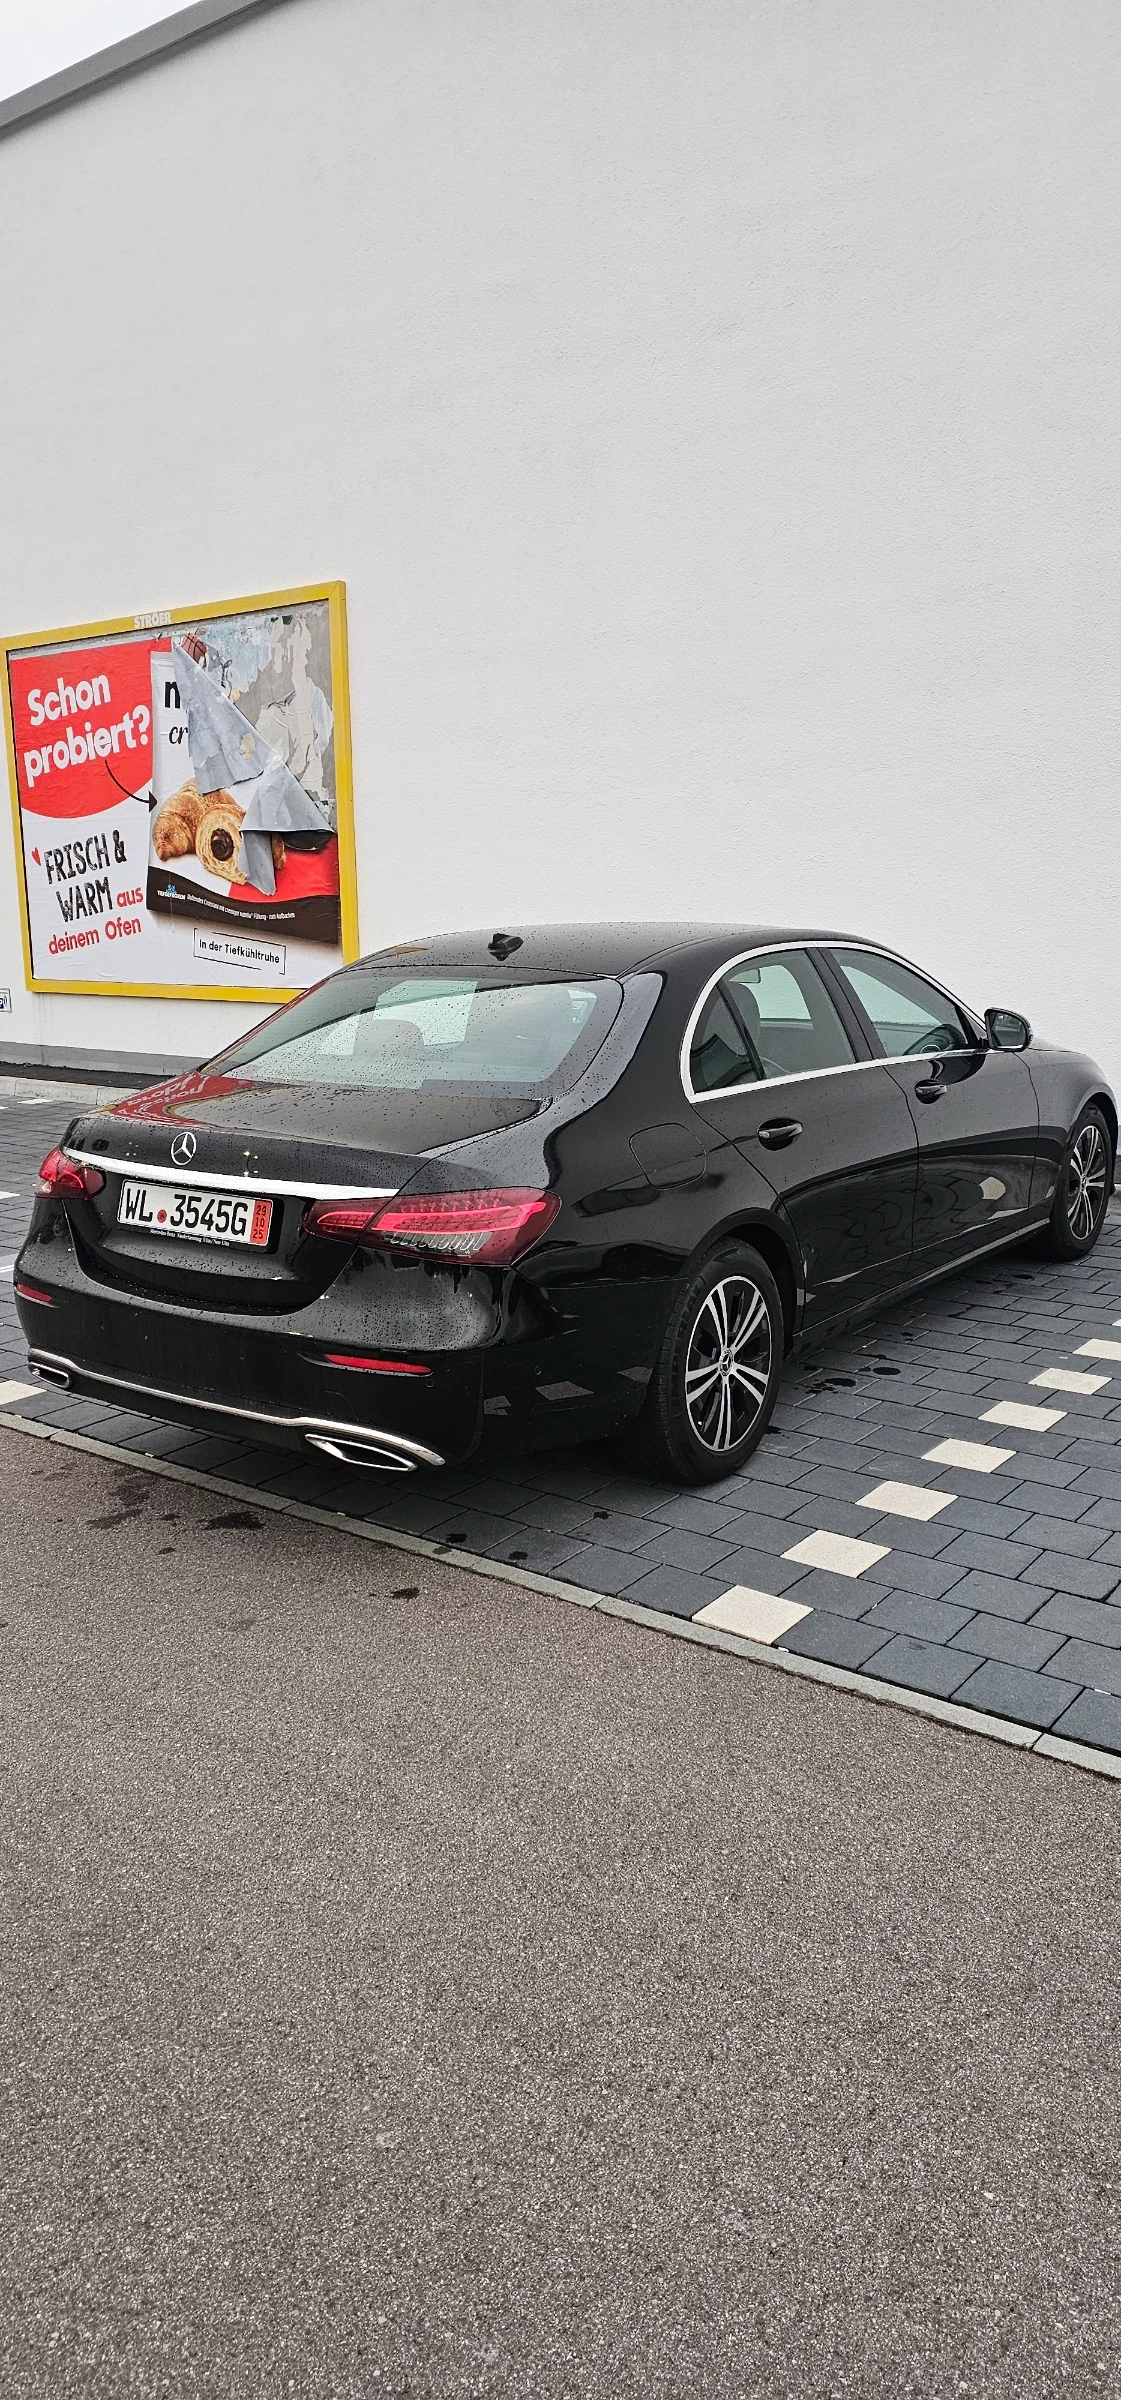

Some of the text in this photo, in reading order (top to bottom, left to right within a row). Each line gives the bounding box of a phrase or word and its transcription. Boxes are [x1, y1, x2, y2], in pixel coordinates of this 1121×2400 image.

[133, 611, 171, 629] STRÖER
[28, 674, 111, 726] Schon
[24, 704, 150, 788] probiert?
[44, 829, 127, 884] FRISCH &
[56, 876, 144, 922] WARM aus
[49, 917, 142, 954] deinem Ofen
[199, 939, 280, 964] In der Tiefkühltruhe
[125, 1188, 249, 1237] WL 3545G
[255, 1204, 267, 1216] 29
[255, 1217, 265, 1228] 10
[252, 1228, 264, 1240] 25
